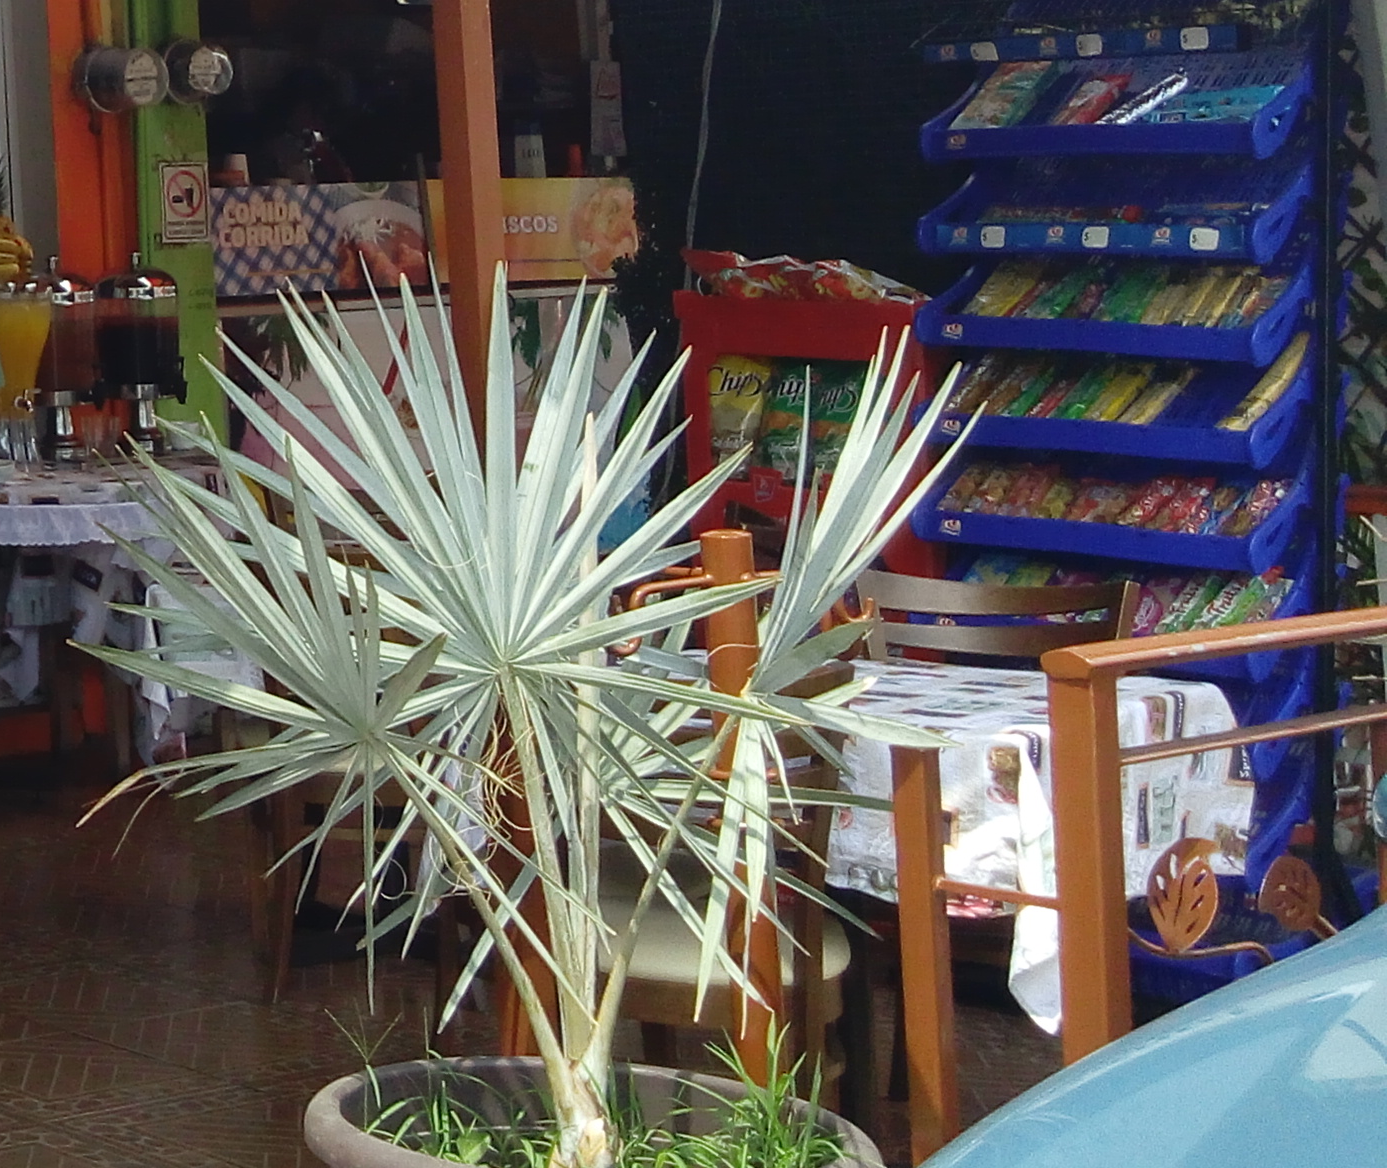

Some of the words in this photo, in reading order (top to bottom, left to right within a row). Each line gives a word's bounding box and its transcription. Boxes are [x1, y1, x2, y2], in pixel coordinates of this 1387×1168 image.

[223, 200, 303, 224] COMIDA
[219, 224, 309, 248] CORRIDA
[709, 366, 764, 397] Chips
